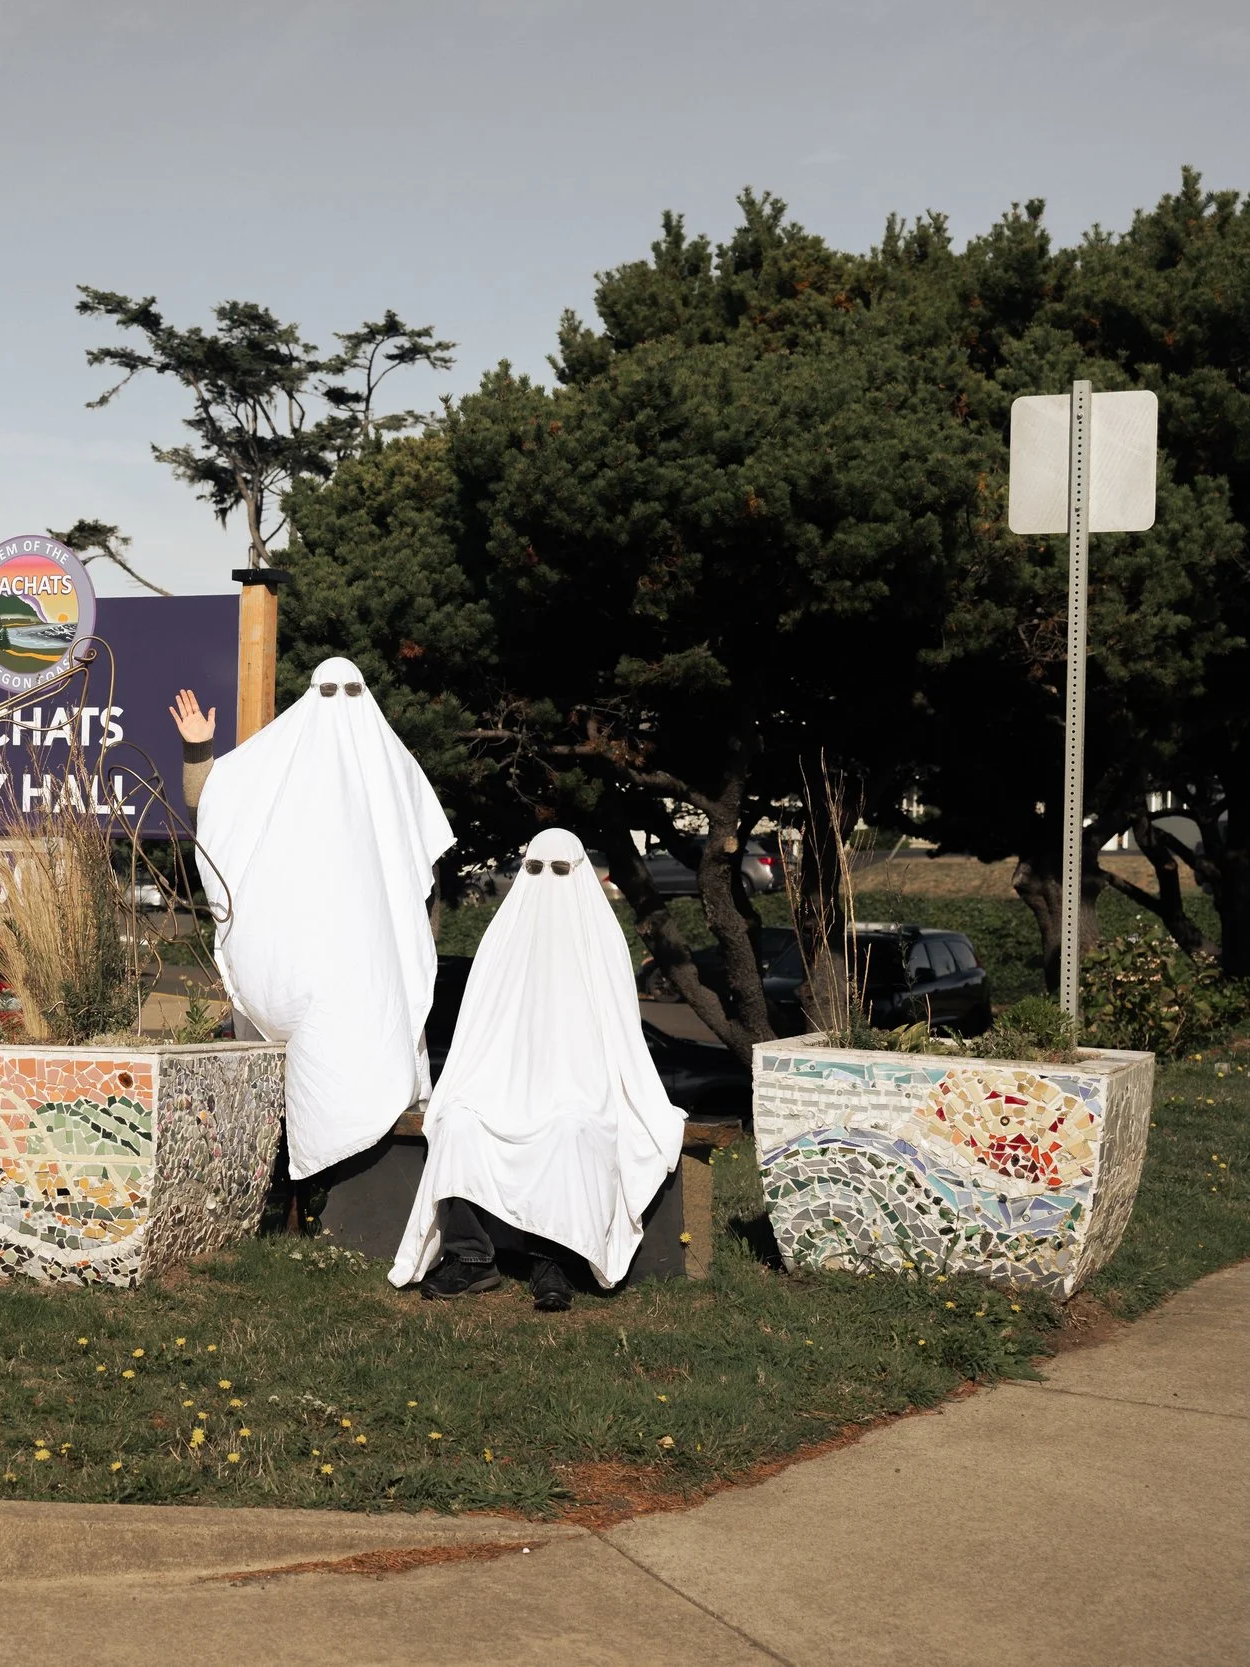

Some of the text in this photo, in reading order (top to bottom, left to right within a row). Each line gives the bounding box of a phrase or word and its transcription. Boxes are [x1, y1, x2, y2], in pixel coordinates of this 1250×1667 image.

[23, 540, 41, 552] OF
[46, 543, 69, 565] THE
[22, 773, 135, 816] HALL
